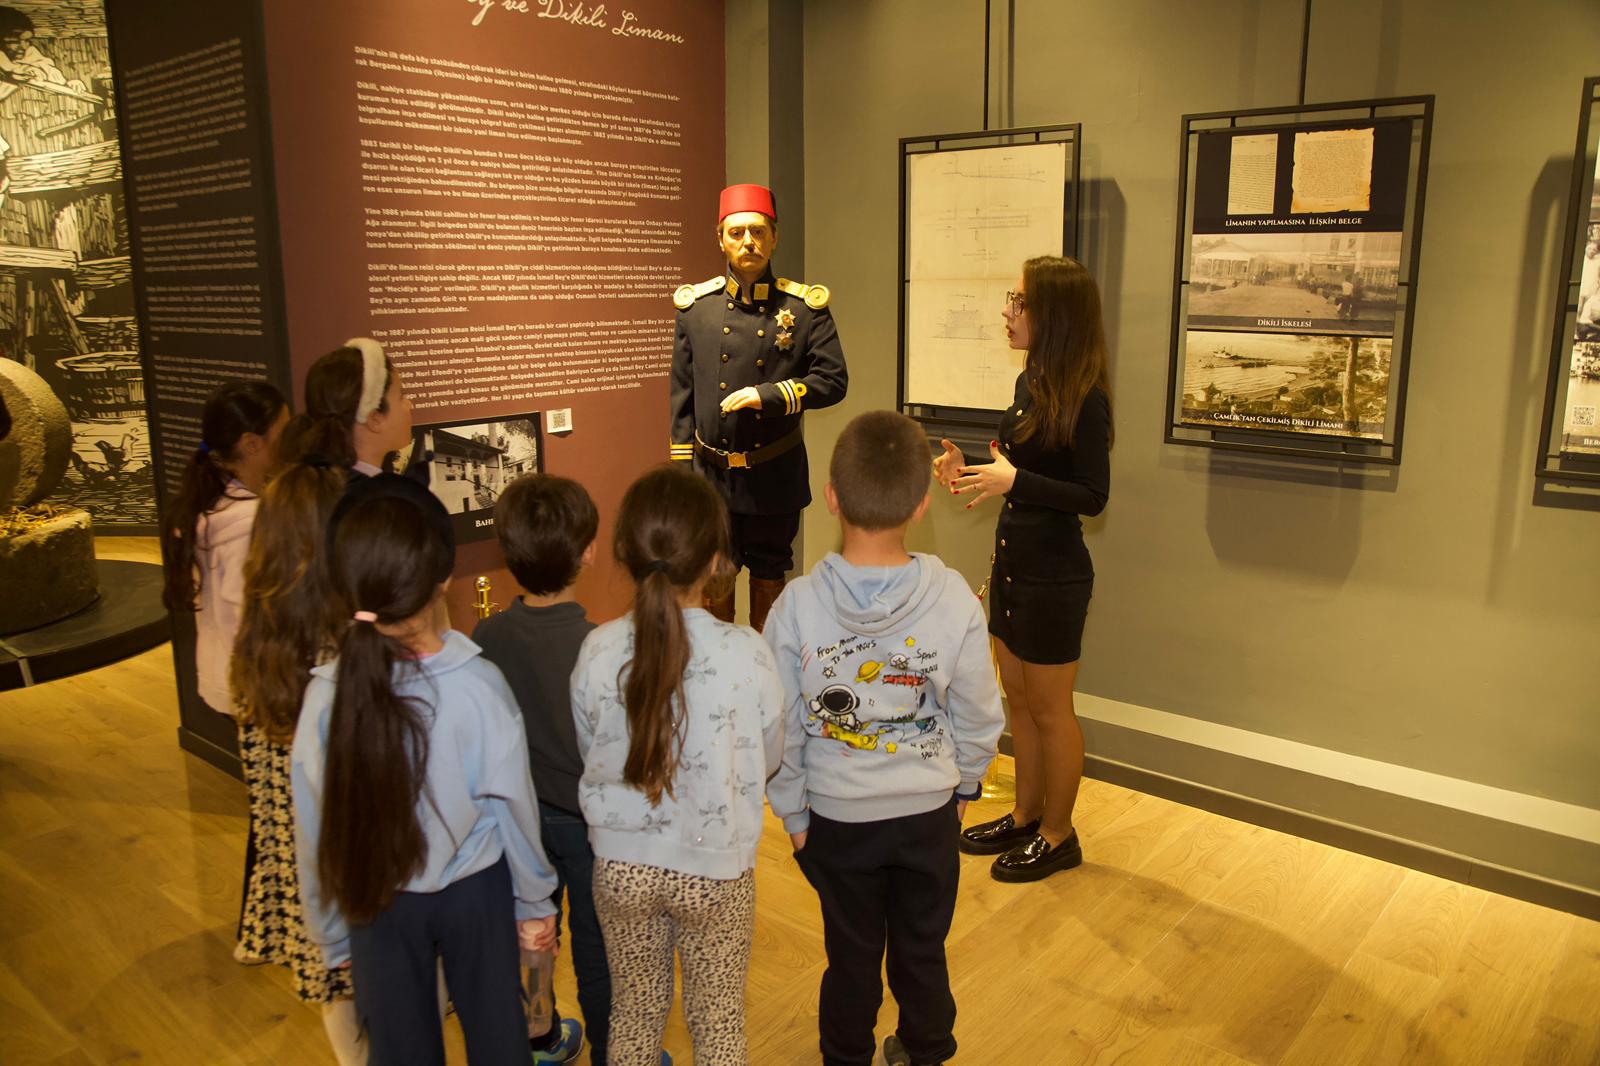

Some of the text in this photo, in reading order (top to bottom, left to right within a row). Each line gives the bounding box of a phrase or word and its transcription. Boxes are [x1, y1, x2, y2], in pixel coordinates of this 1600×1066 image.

[537, 0, 607, 28] Dikili
[611, 9, 685, 44] Limanı
[1225, 217, 1363, 227] LİMANIN YAPILMASINA İLİŞKİN BELGE
[1316, 420, 1344, 429] LİMANI
